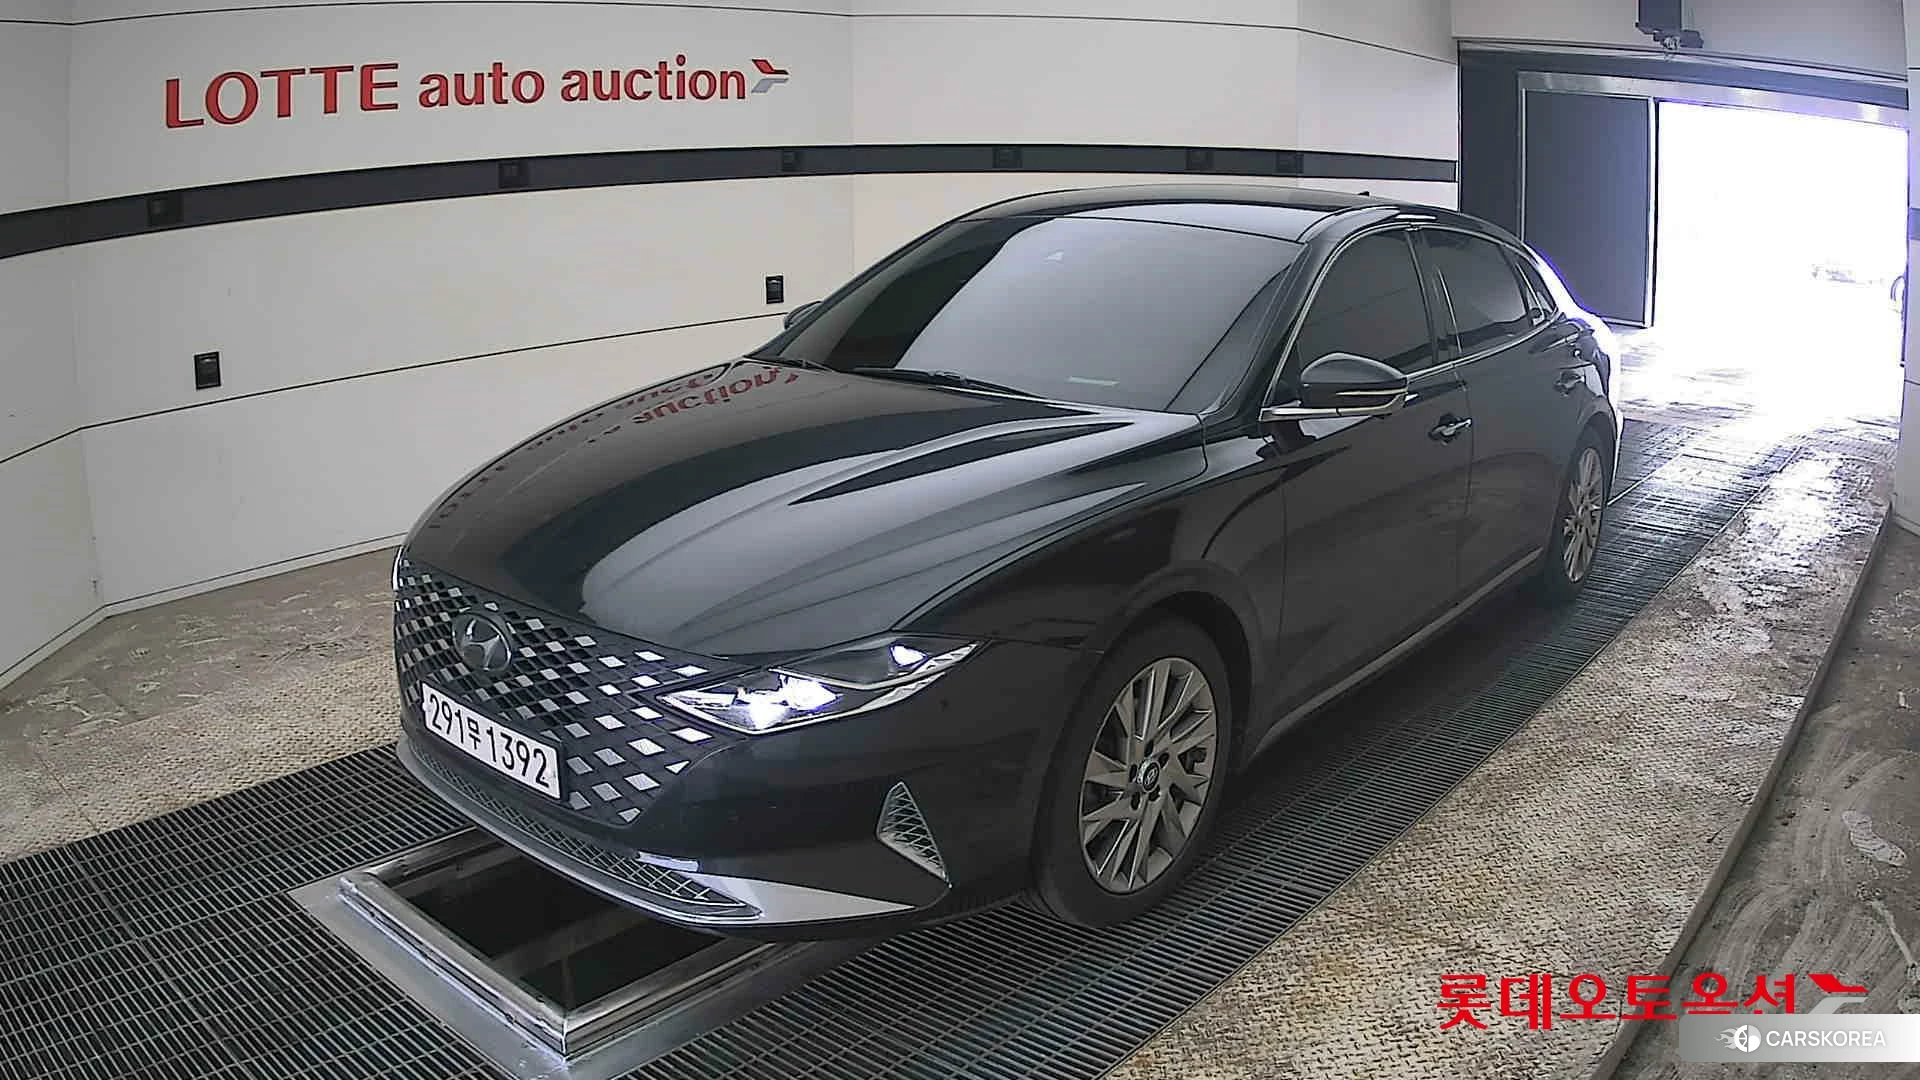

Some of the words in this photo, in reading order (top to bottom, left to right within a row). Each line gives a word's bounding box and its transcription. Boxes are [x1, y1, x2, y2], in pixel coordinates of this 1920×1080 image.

[165, 62, 399, 129] LOTTE
[418, 61, 545, 108] auto
[560, 54, 747, 101] auction
